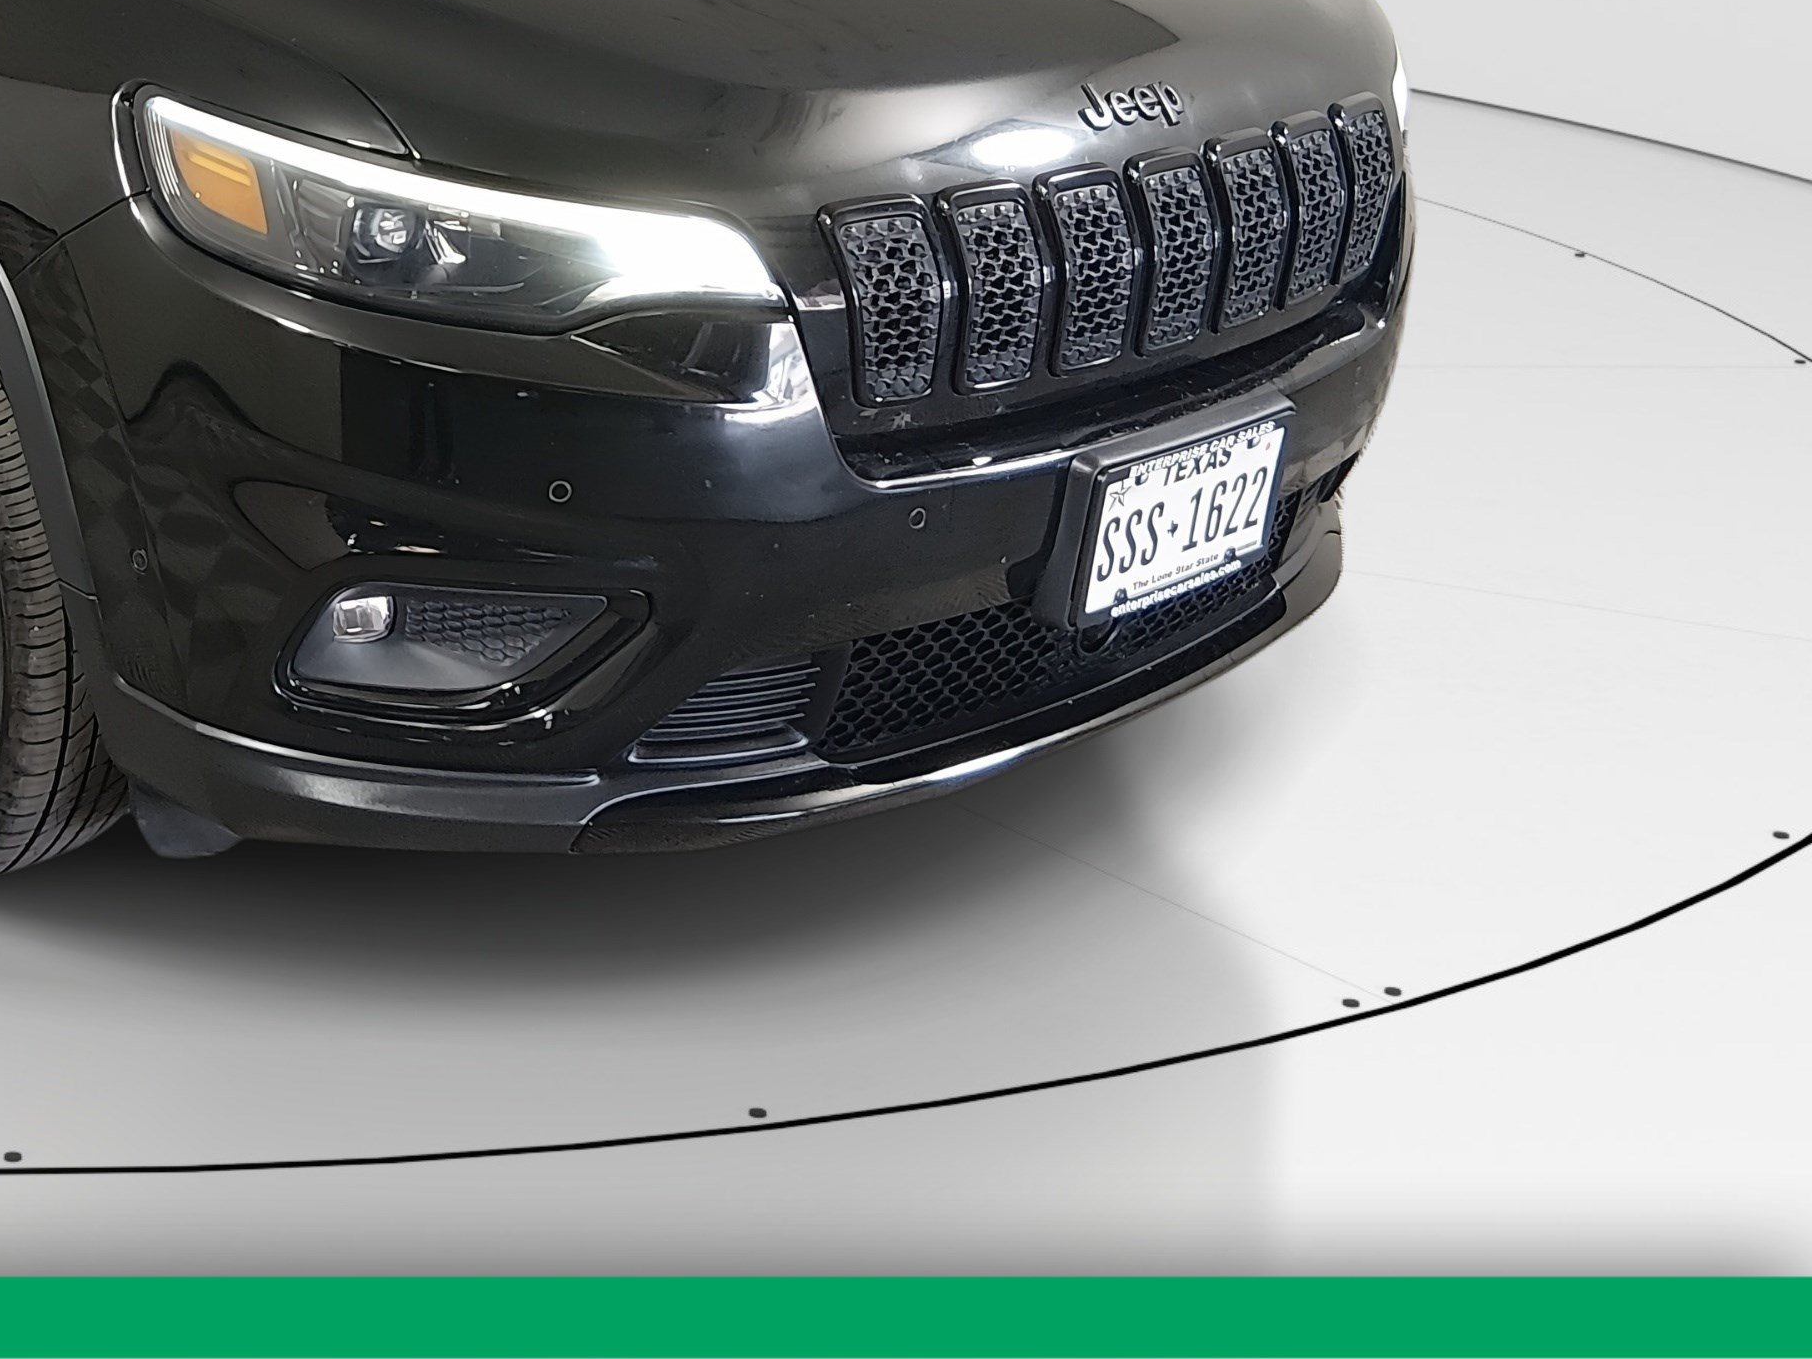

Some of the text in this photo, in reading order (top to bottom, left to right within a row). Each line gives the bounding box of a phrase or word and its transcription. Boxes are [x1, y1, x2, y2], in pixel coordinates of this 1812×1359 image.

[1078, 81, 1184, 131] Jeep
[1129, 421, 1276, 479] ENTERPRISE CAR SALES
[1164, 448, 1232, 487] TEXAS
[1110, 559, 1242, 618] enterprisecarsales.com
[1133, 553, 1219, 591] The Lone Star State
